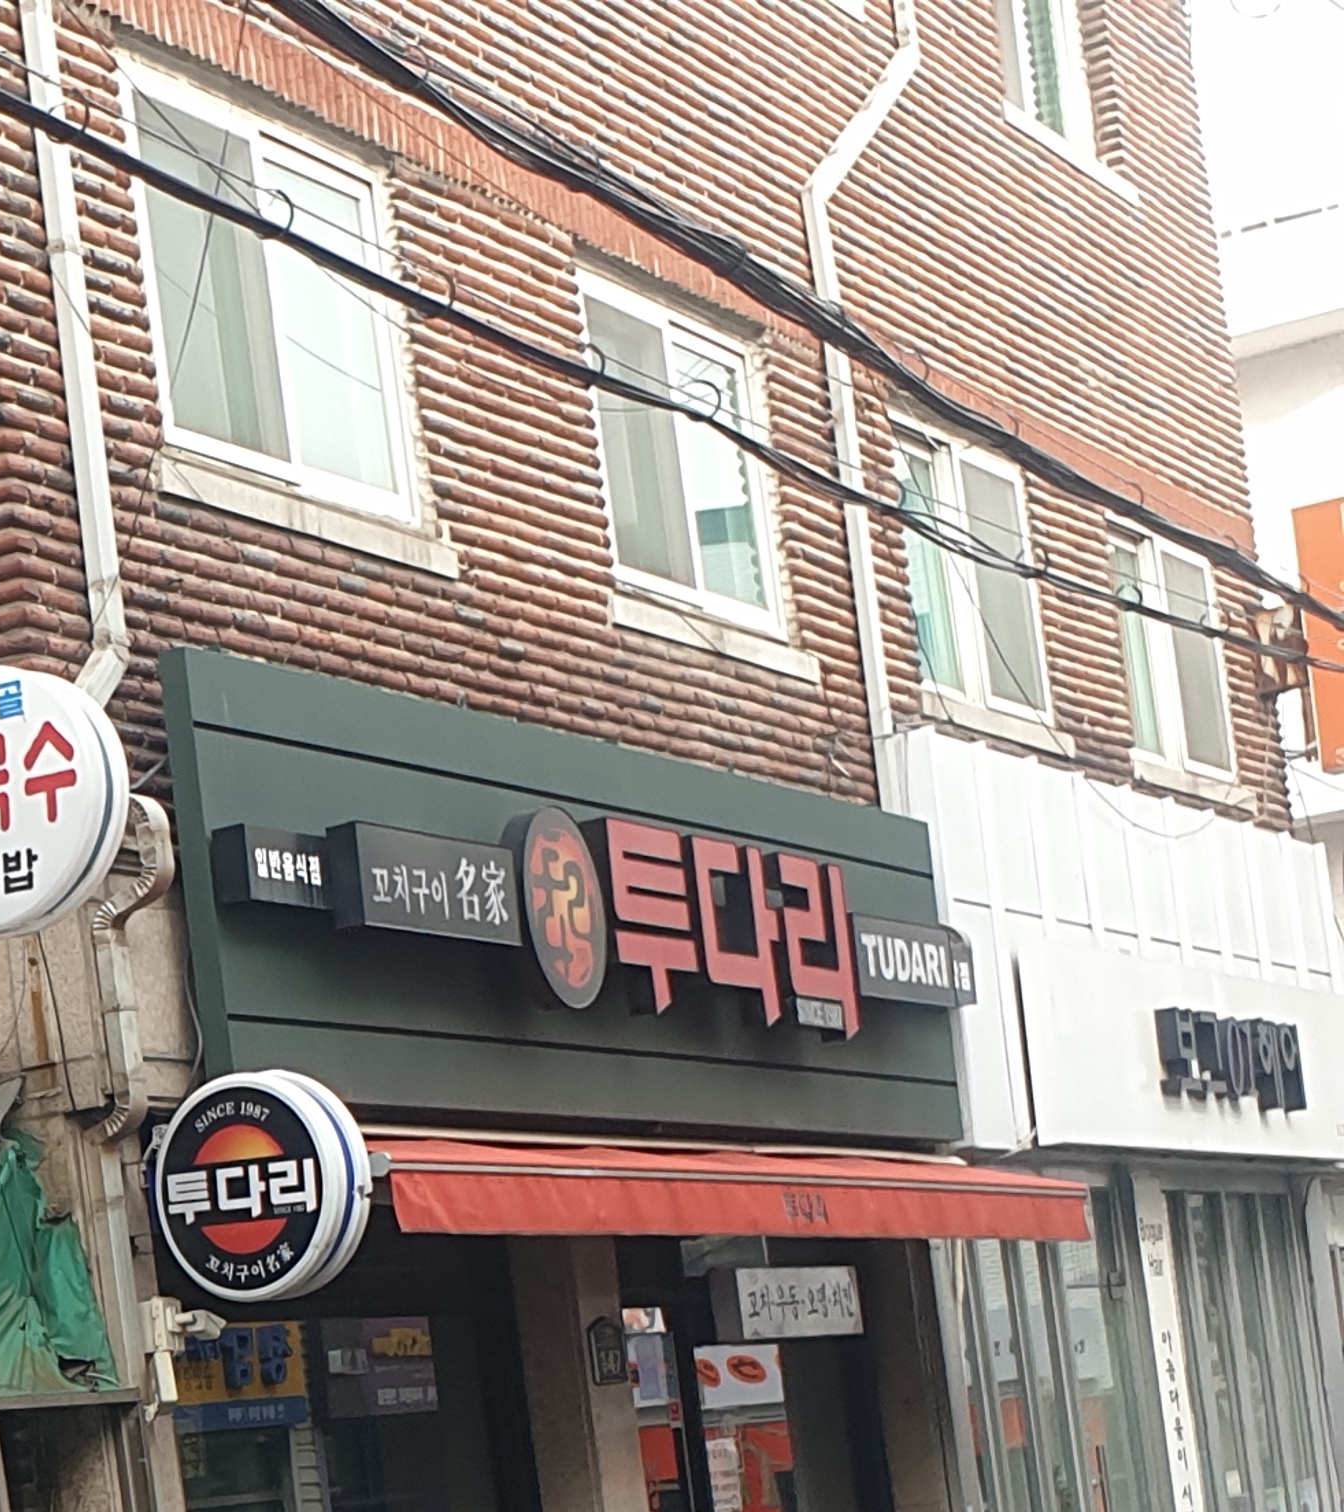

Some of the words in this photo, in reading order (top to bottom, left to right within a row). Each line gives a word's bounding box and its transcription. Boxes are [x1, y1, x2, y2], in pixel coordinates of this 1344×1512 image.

[254, 847, 322, 887] 일반음식점
[371, 864, 450, 920] 꼬치구이
[454, 857, 509, 925] 名家
[606, 816, 861, 1041] 투다리
[860, 932, 950, 989] TUDARI
[194, 1101, 235, 1134] SINCE
[240, 1101, 271, 1123] 1987
[165, 1157, 318, 1226] 투다리
[205, 1253, 266, 1284] 꼬치구이
